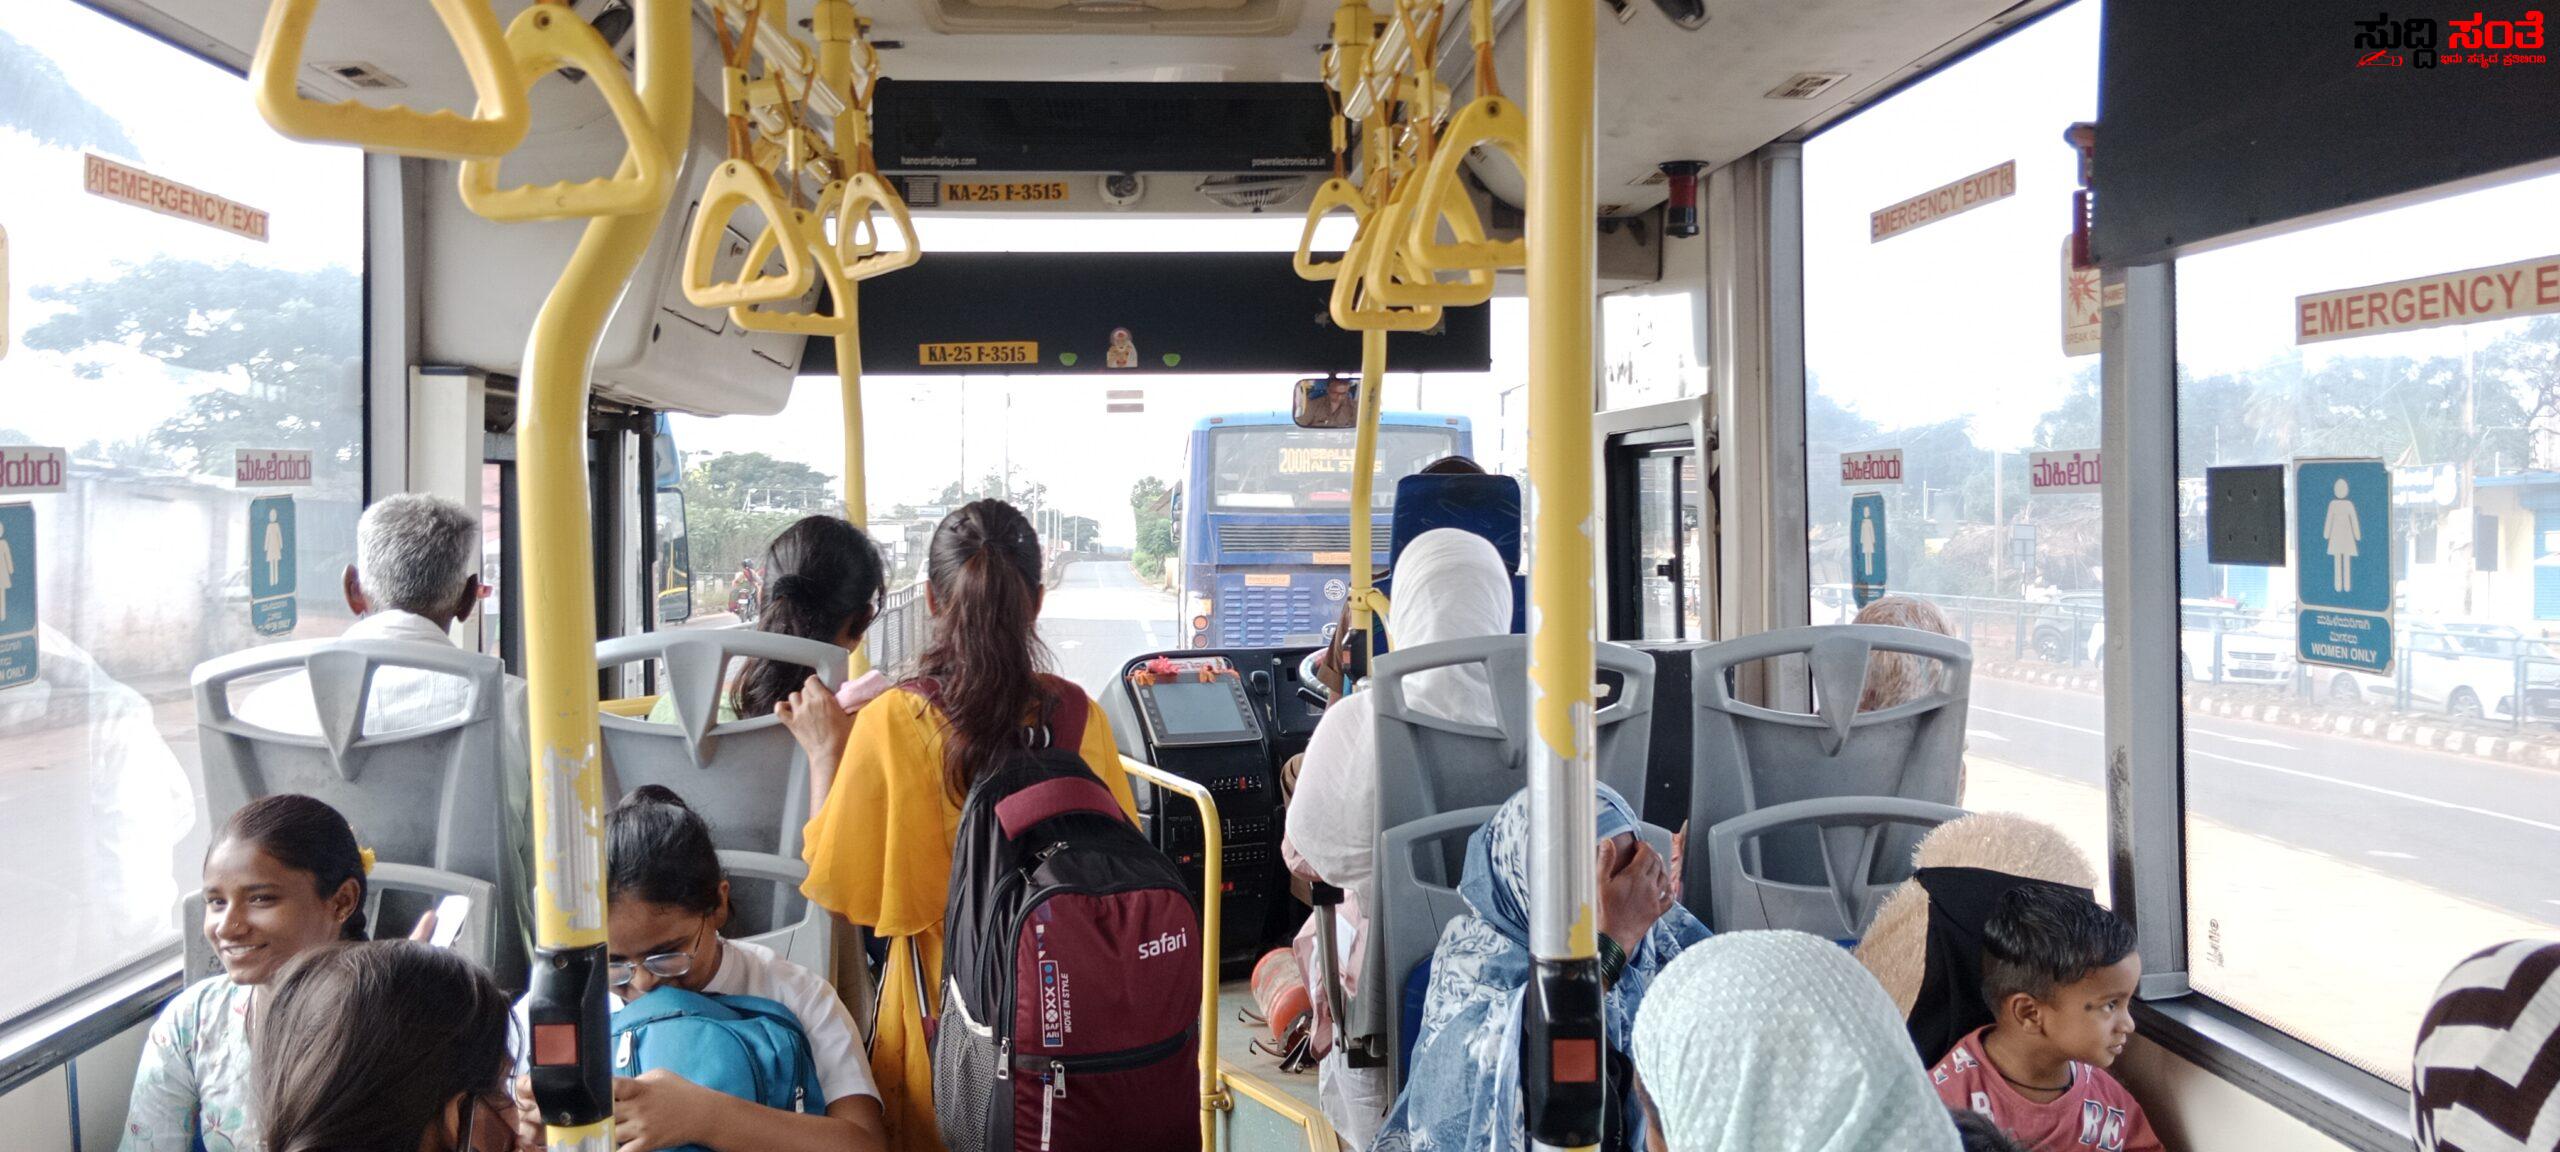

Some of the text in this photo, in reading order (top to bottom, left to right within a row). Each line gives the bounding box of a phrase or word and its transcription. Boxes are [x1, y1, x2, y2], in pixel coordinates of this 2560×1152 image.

[106, 167, 266, 237] EMERGENCY EXIT
[948, 183, 1062, 201] KA-25 F-3515
[1872, 171, 1999, 239] EMERGENCY EXIT
[2301, 271, 2522, 337] EMERGENCY
[928, 345, 1026, 362] KA-25 F-3515
[237, 452, 311, 482] ಮಹಿಳೆಯರು
[1842, 454, 1900, 481] ಮಹಿಳೆಯರು
[2033, 453, 2101, 487] ಮಹಿಳೆಯ
[2311, 642, 2377, 663] WOMEN ONLY
[1138, 928, 1188, 959] safari
[1061, 973, 1072, 1033] MOVE IN STYLE
